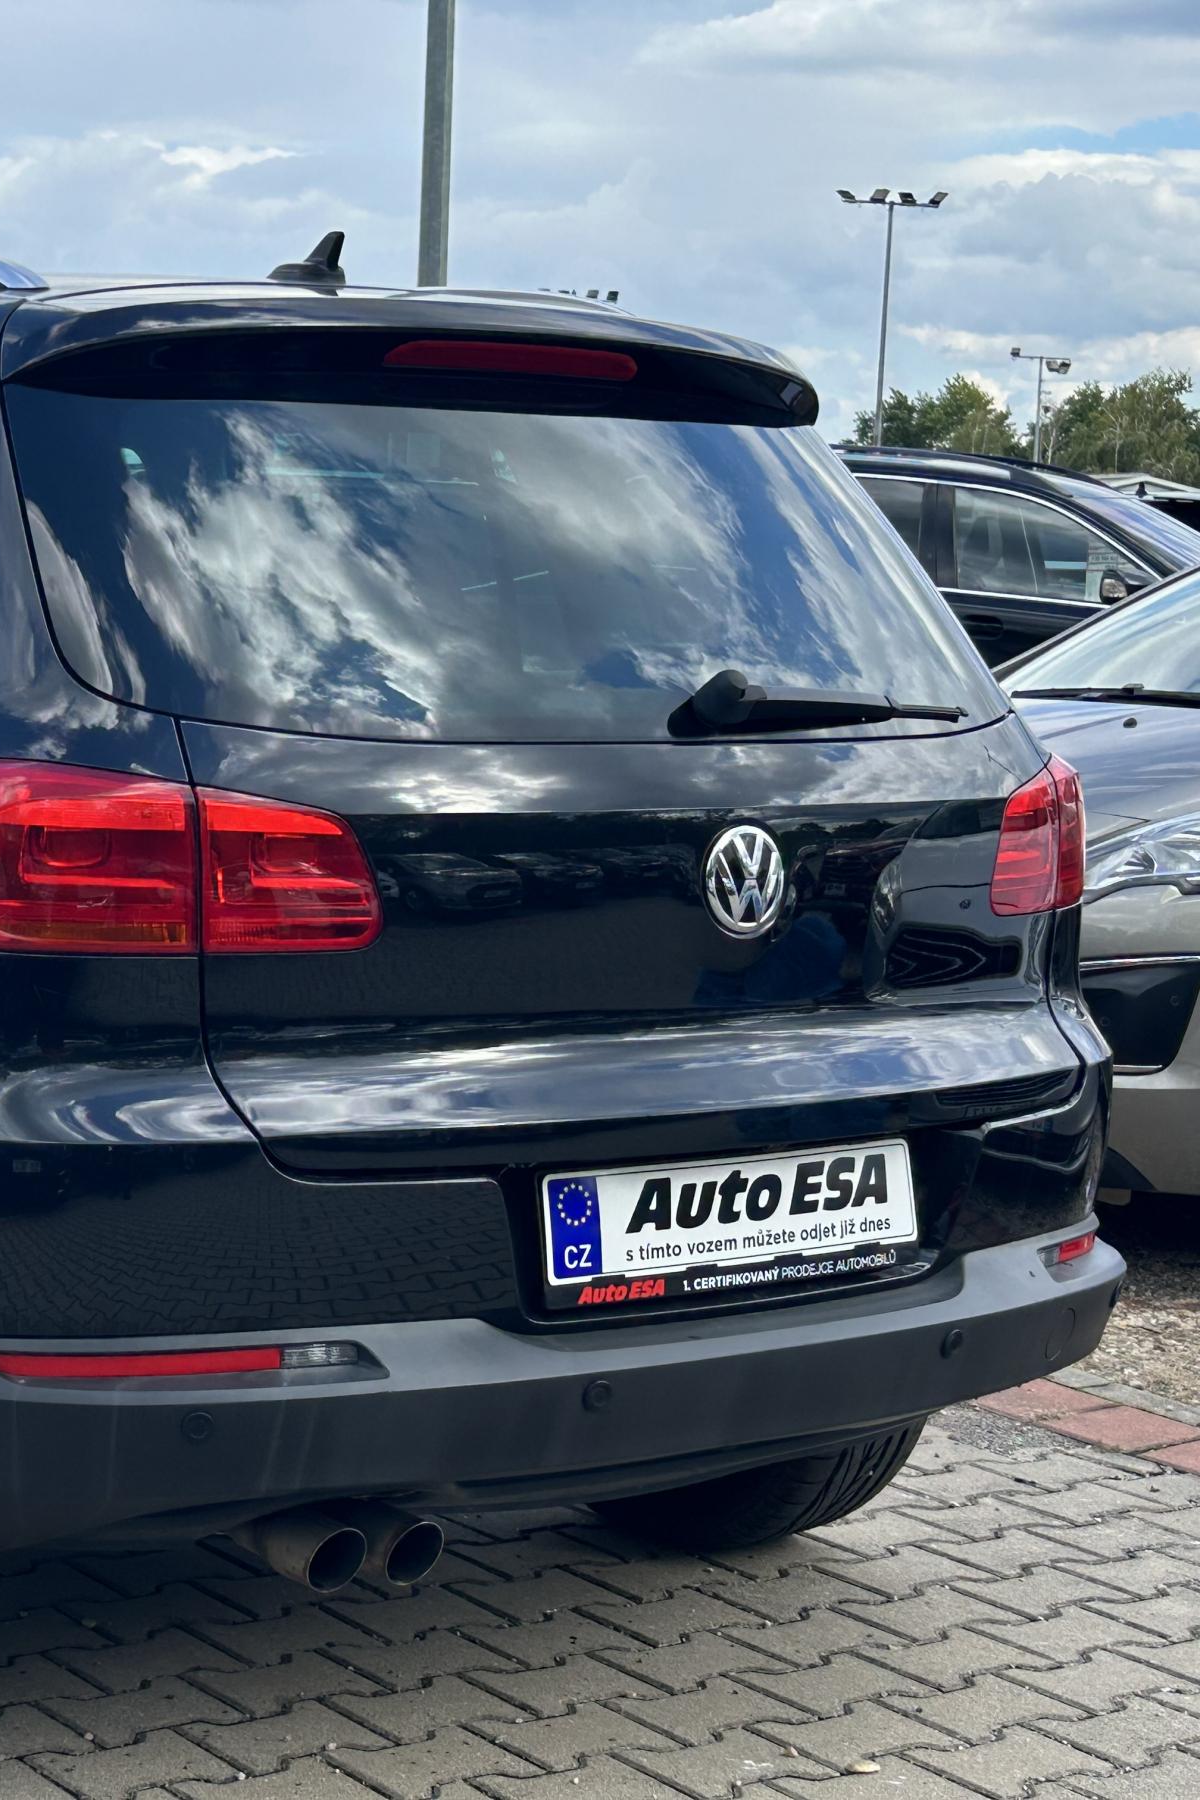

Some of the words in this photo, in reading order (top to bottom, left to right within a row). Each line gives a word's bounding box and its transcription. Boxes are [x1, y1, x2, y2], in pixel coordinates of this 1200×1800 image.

[625, 1169, 782, 1234] Auto
[789, 1153, 888, 1216] ESA
[564, 1243, 592, 1269] CZ
[626, 1249, 634, 1262] s
[639, 1242, 682, 1260] tímto
[687, 1237, 738, 1255] vozem
[743, 1228, 796, 1249] můžete
[800, 1223, 837, 1241] odjet
[840, 1218, 856, 1239] již
[859, 1216, 891, 1233] dnes
[578, 1283, 628, 1305] Auto
[629, 1278, 665, 1299] ESA
[683, 1279, 691, 1292] 1.
[693, 1266, 780, 1291] CERTIFIKOVANÝ
[781, 1260, 835, 1280] PRODEJCE
[835, 1248, 897, 1273] AUTOMOBILŮ
